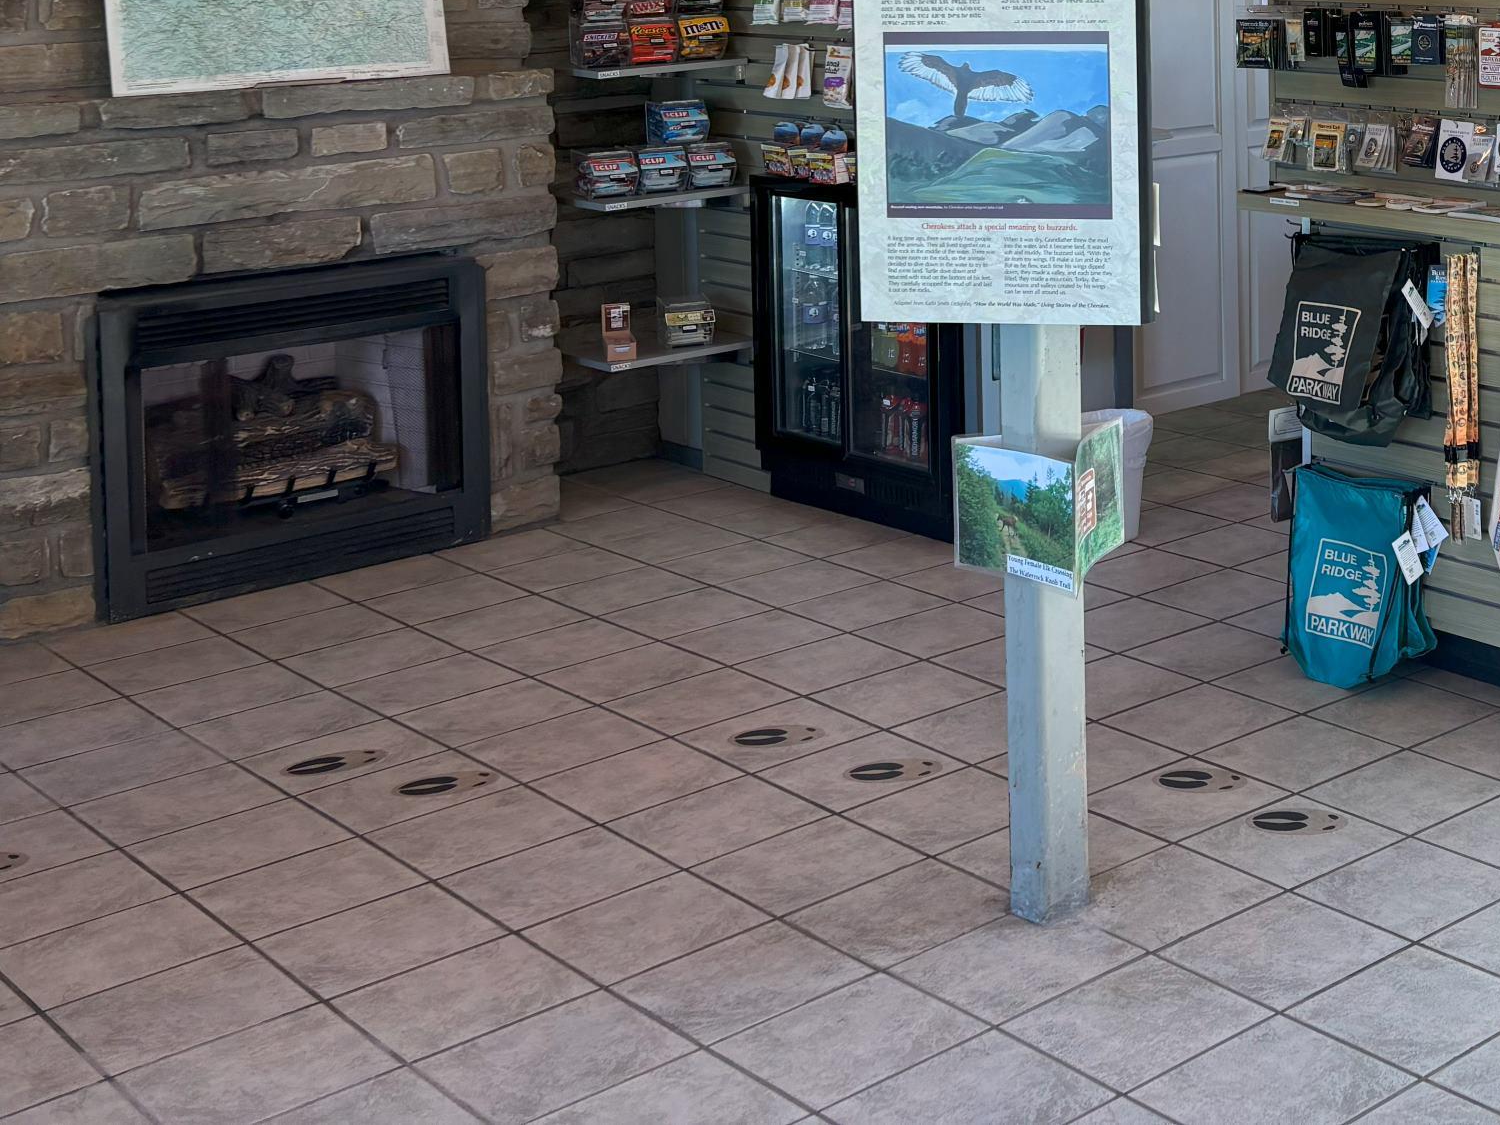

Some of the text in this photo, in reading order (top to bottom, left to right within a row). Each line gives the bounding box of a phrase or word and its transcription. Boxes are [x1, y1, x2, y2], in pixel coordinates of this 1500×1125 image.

[984, 224, 1006, 232] special
[1008, 224, 1036, 232] meaning
[1302, 311, 1331, 324] BLUE
[1300, 326, 1331, 340] RIDGE
[1291, 377, 1338, 402] PARKWAY
[1025, 559, 1041, 568] Female
[1324, 549, 1357, 565] BLUE
[1321, 564, 1362, 582] RIDGE
[1045, 576, 1058, 585] Knob
[1060, 581, 1071, 589] Trail
[1311, 616, 1373, 644] PARKWAY
